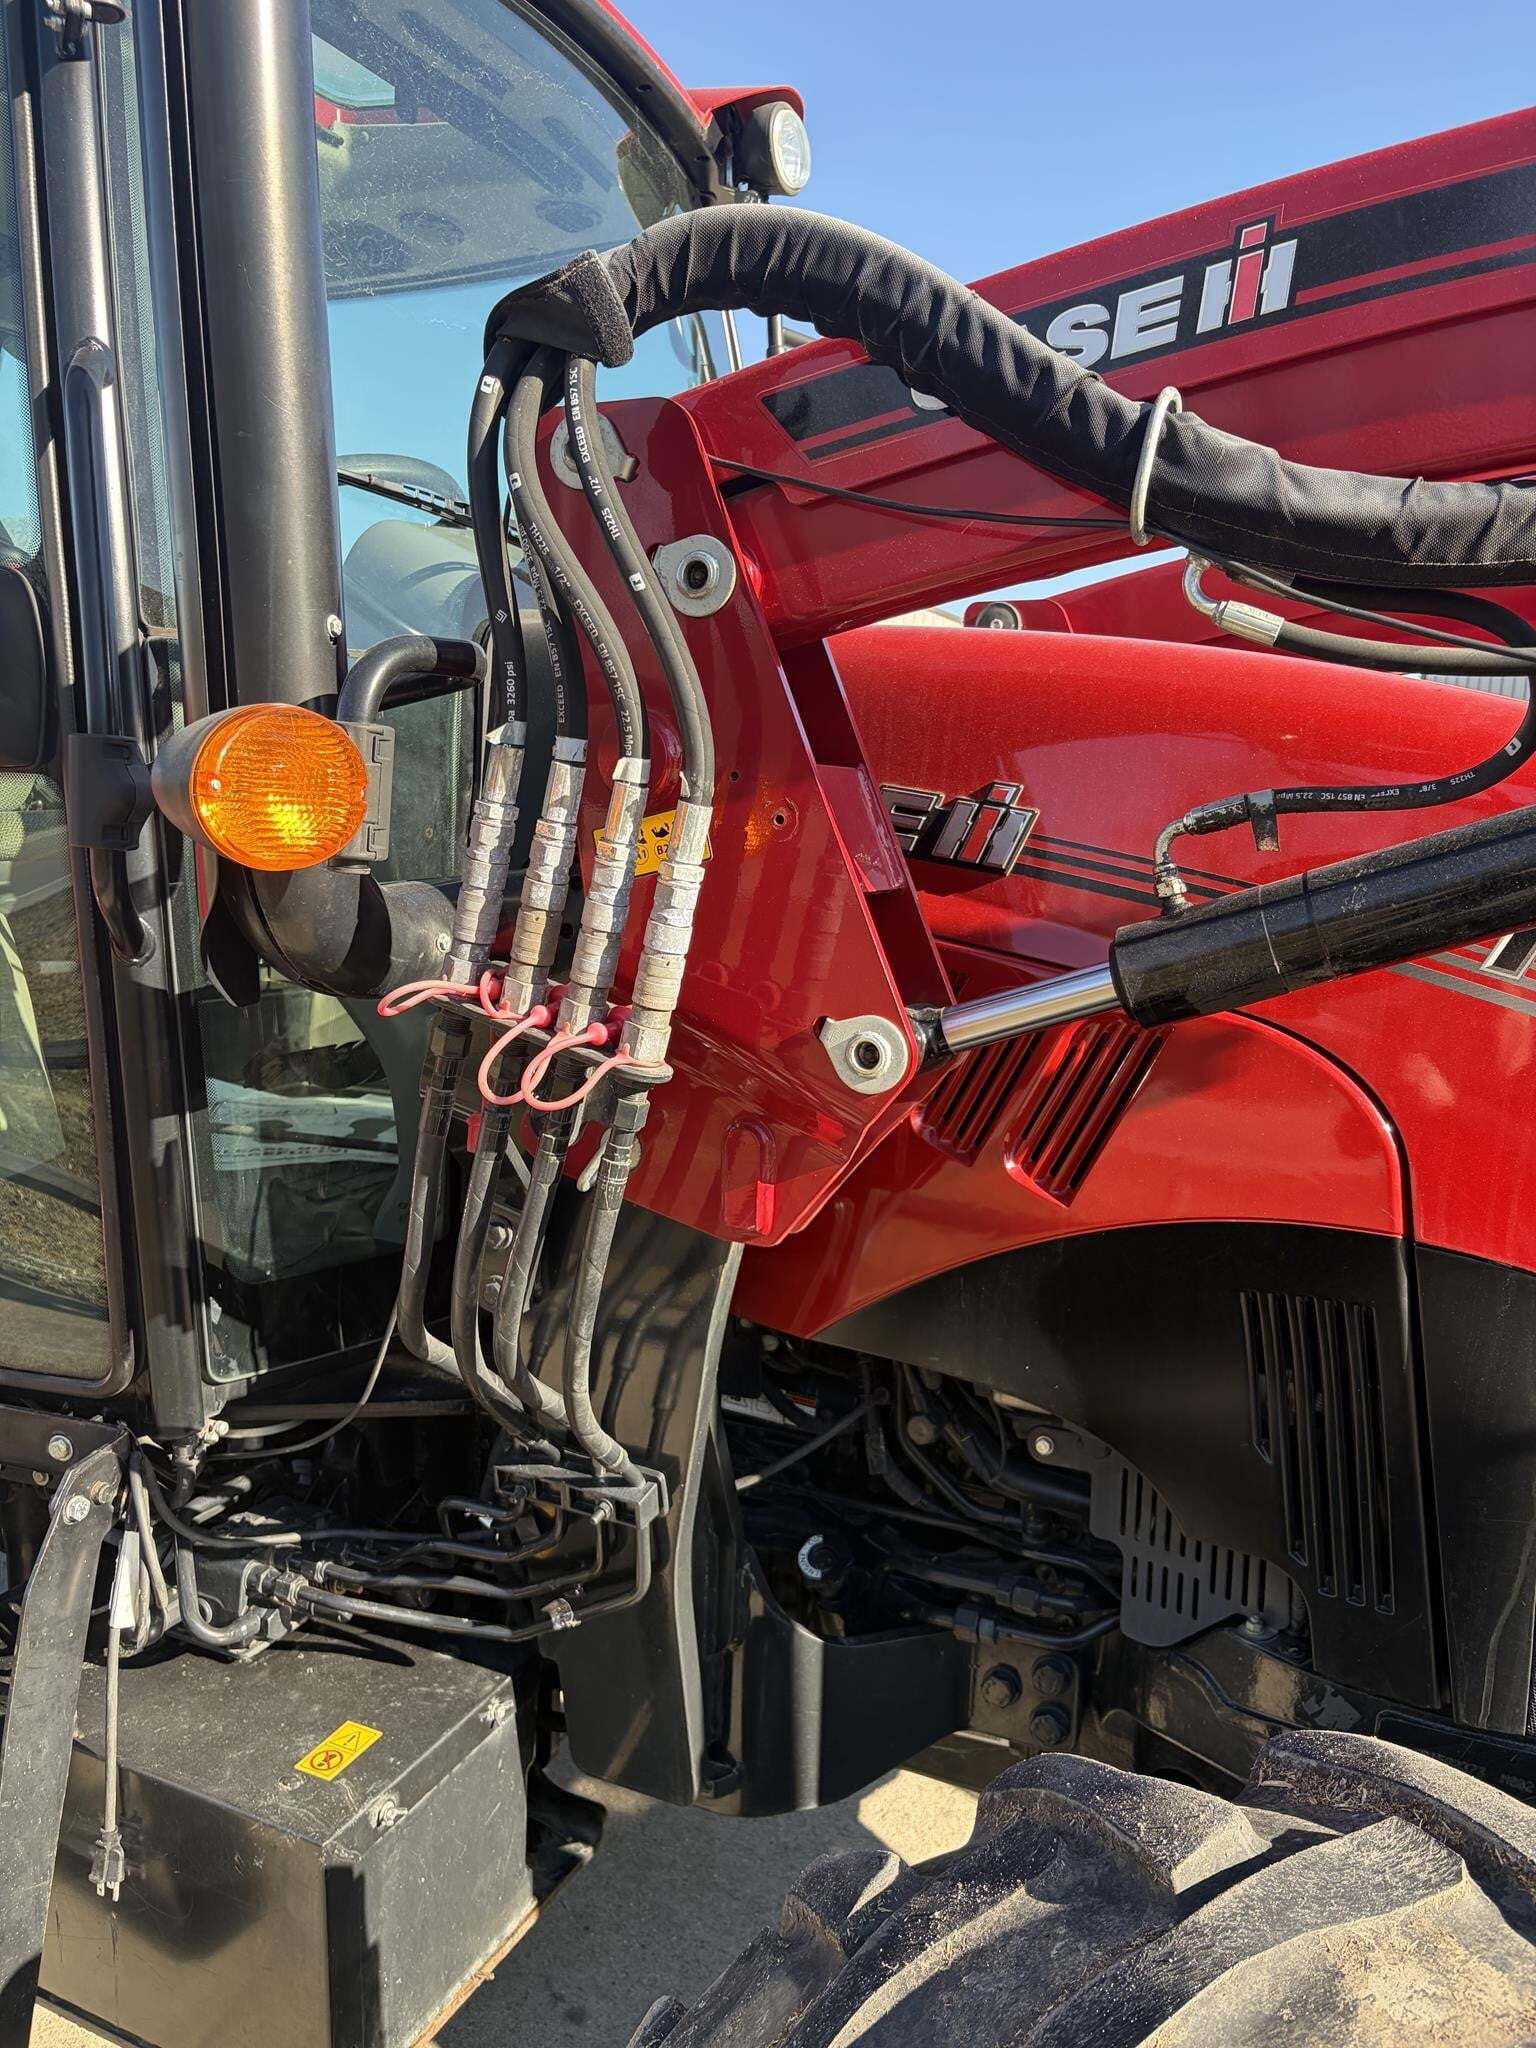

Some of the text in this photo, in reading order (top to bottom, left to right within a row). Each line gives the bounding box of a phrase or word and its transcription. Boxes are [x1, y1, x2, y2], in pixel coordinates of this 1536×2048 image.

[570, 388, 579, 406] 857
[571, 406, 581, 422] EN
[575, 426, 591, 463] EXCEED
[588, 475, 602, 496] 1/2"
[601, 507, 621, 541] TH225
[529, 521, 550, 556] TH225
[574, 599, 599, 637] EXCEED
[597, 643, 609, 659] EN
[605, 659, 618, 679] 857
[621, 710, 633, 732] 22.5
[504, 661, 517, 676] psi
[553, 663, 562, 678] EN
[506, 678, 515, 705] 3260
[557, 684, 565, 723] EXCEED
[1450, 771, 1476, 785] TH225
